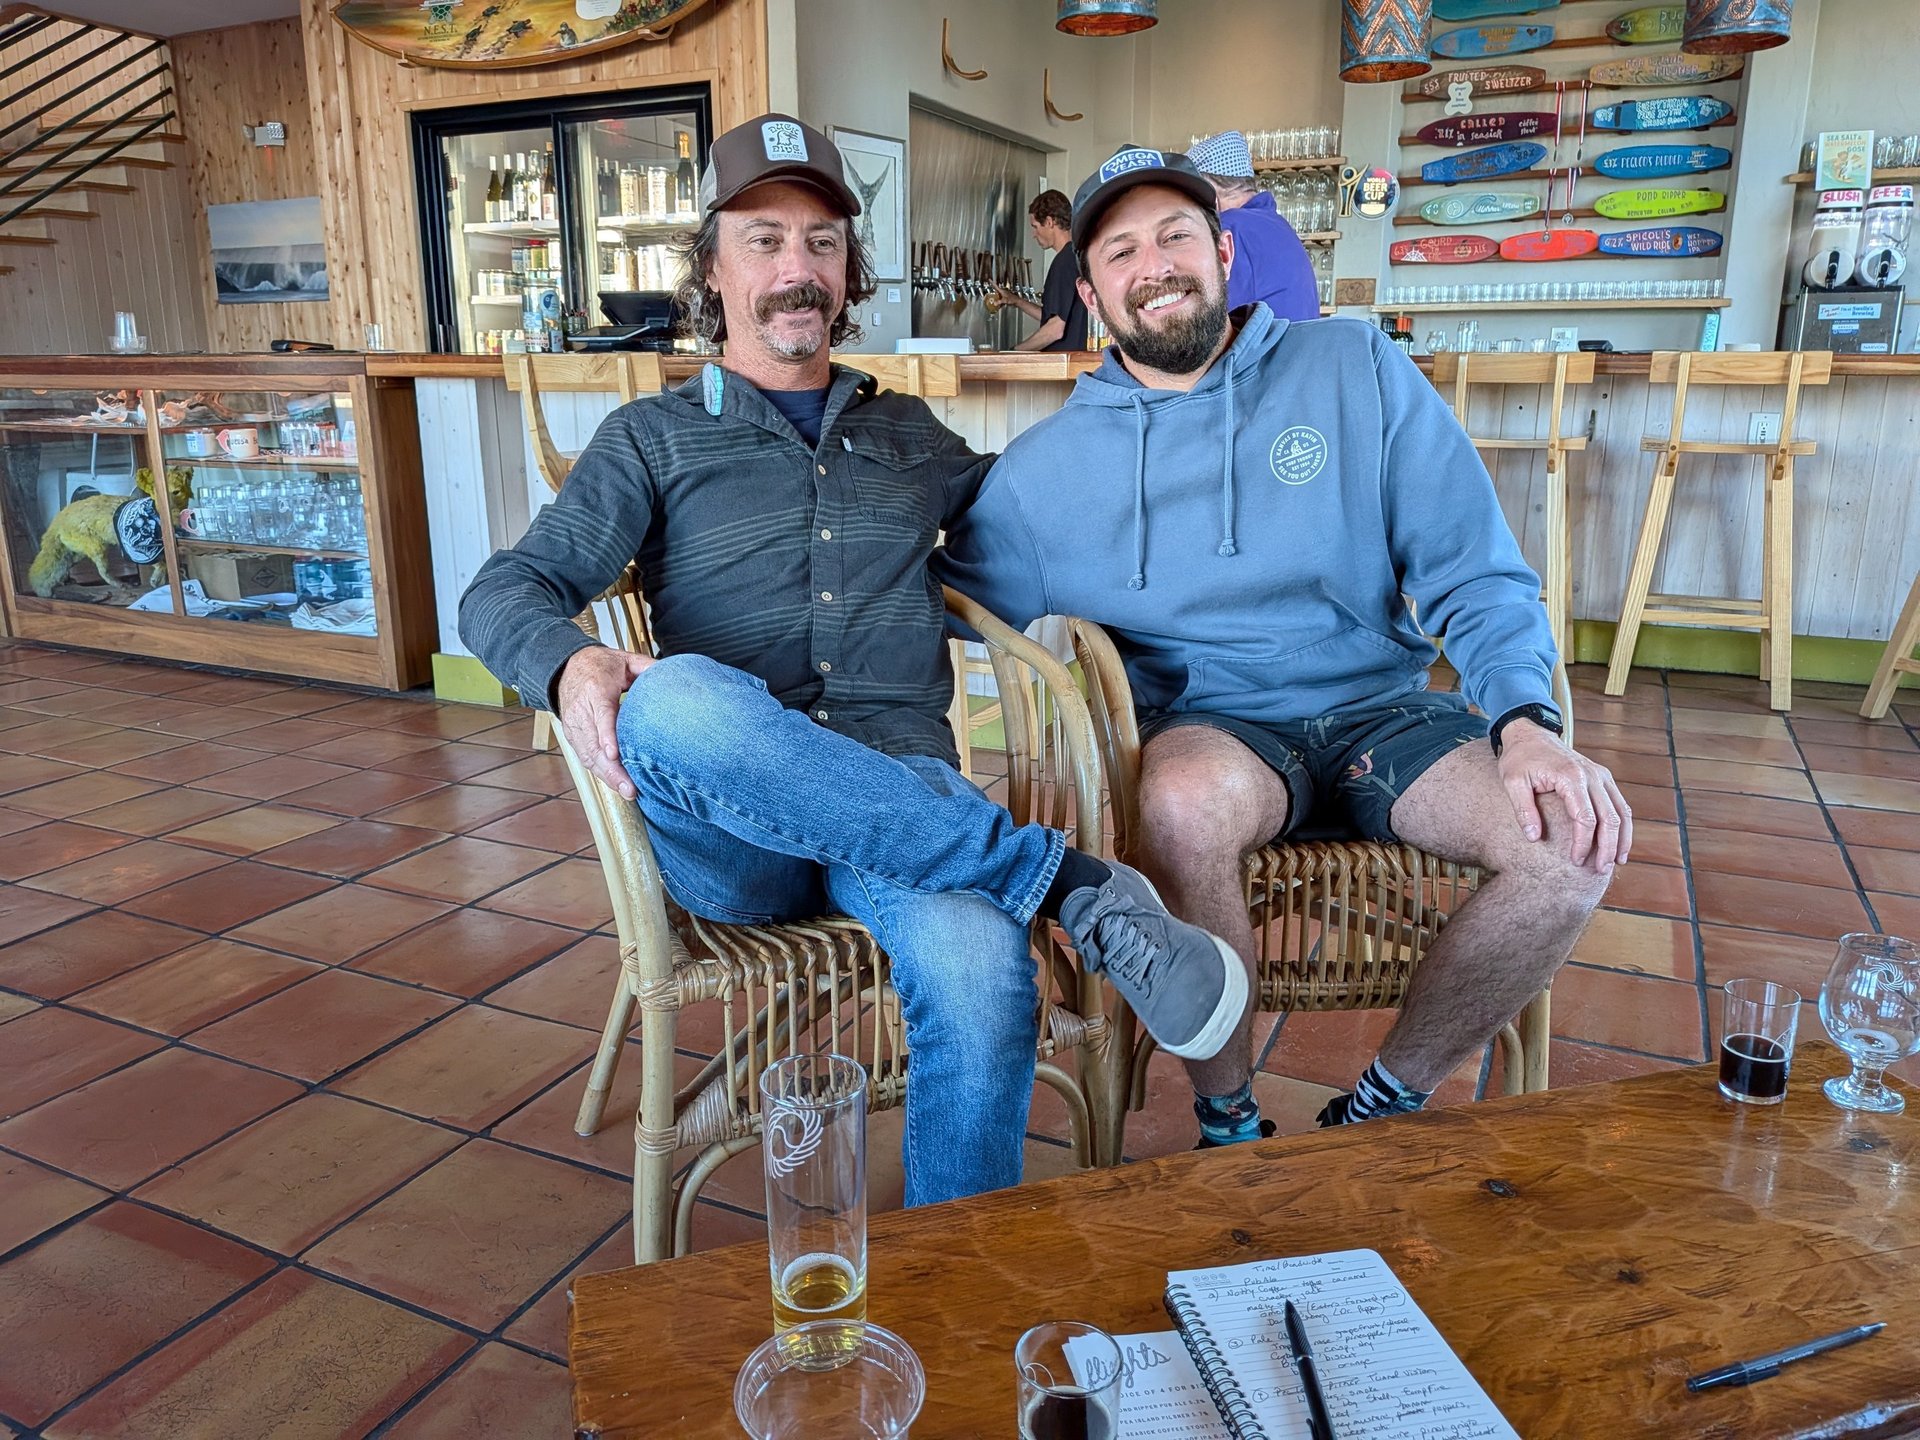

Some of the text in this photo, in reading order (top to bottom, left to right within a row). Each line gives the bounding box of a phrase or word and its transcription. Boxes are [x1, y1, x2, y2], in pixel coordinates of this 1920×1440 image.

[424, 24, 457, 36] N.E.S.T.
[1448, 72, 1486, 82] FRUITED
[1485, 77, 1532, 90] SWELTZER
[1460, 117, 1505, 129] CALLED
[1105, 152, 1157, 171] OMEGA
[1111, 160, 1153, 173] YEAST
[1363, 183, 1388, 191] BEER
[1364, 191, 1385, 200] CUP
[1823, 191, 1860, 203] SLUSH
[1626, 229, 1671, 242] SPICOLI'S
[1631, 241, 1652, 251] WILD
[1653, 241, 1671, 250] RIDE
[1278, 465, 1287, 475] SEE
[1300, 469, 1311, 478] OUT
[1311, 451, 1321, 469] THERE
[1086, 1341, 1171, 1388] flights
[1168, 1385, 1187, 1393] FOR
